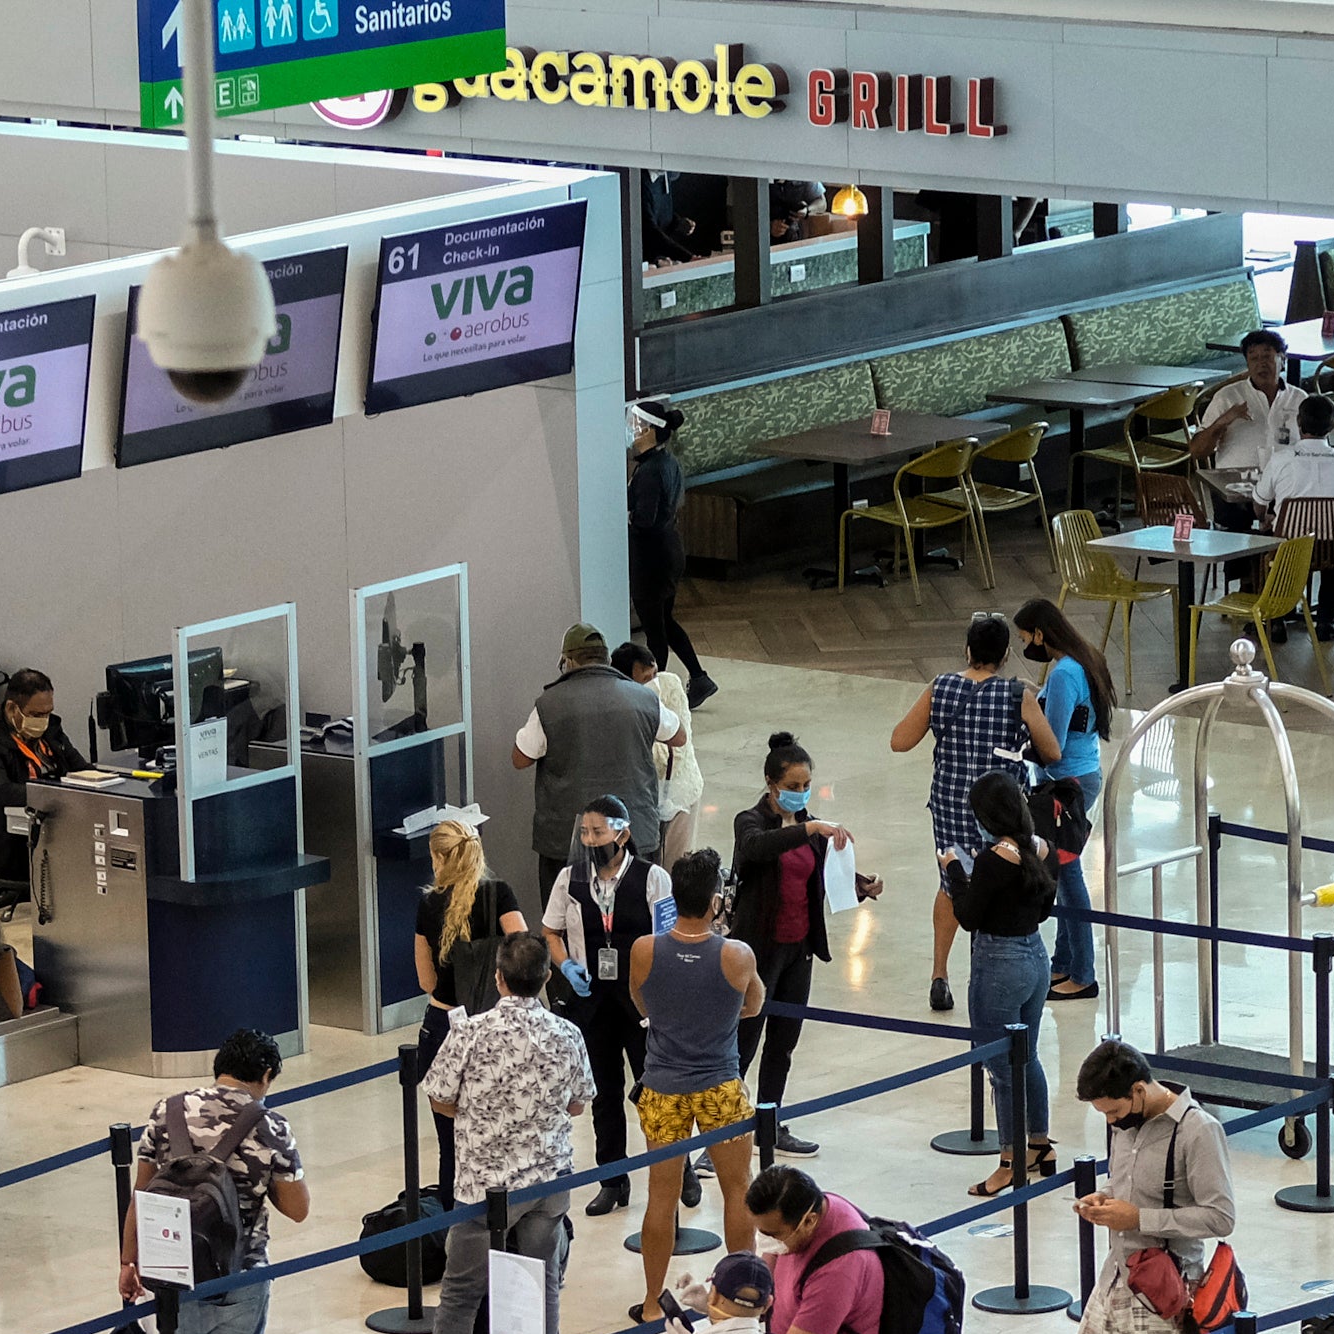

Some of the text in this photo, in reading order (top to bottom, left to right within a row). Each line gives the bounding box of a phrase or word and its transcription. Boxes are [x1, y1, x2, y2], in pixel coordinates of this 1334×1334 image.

[355, 0, 452, 34] Sanitarios
[807, 68, 996, 139] GRILL
[388, 216, 545, 275] 61 Documentación
[443, 244, 500, 265] Check-in
[464, 312, 530, 338] aerobus
[488, 339, 506, 351] para
